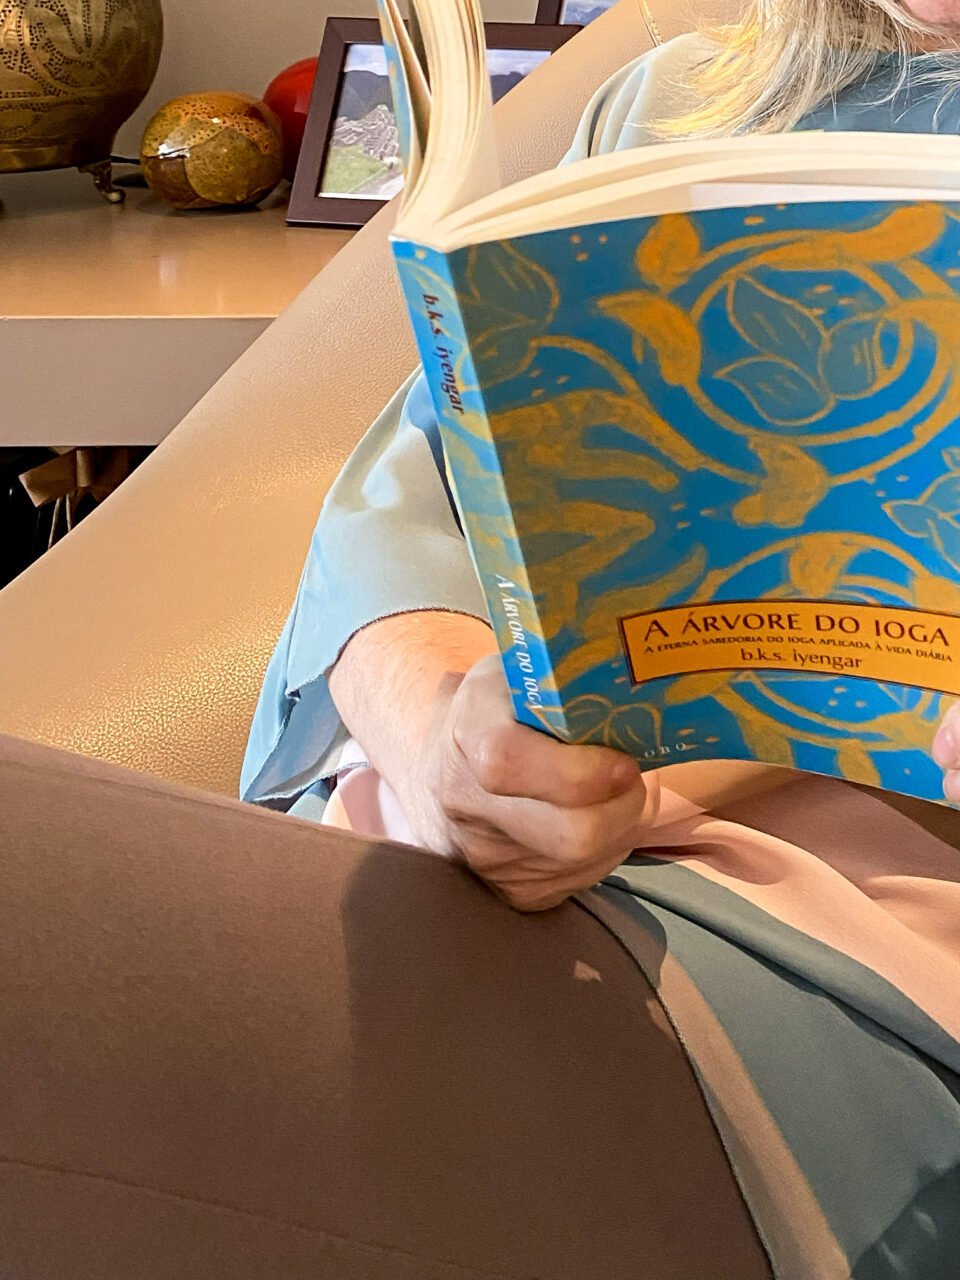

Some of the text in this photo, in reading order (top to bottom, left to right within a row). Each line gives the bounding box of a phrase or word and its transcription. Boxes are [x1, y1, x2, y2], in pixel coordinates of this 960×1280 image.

[423, 294, 465, 415] b.k.s. iyengar
[496, 574, 544, 710] A ÁRVORE DO IOGA
[644, 612, 949, 646] A ÁRVORE DO IOGA
[645, 646, 655, 654] A
[657, 640, 699, 652] ETERNA
[702, 636, 763, 645] SABEDORIA
[788, 636, 816, 644] IOGA
[818, 638, 871, 650] APLICADA
[874, 642, 883, 652] À
[885, 644, 912, 656] VIDA
[915, 647, 953, 662] DIÁRIA
[740, 648, 862, 670] b.k.s. iyengar
